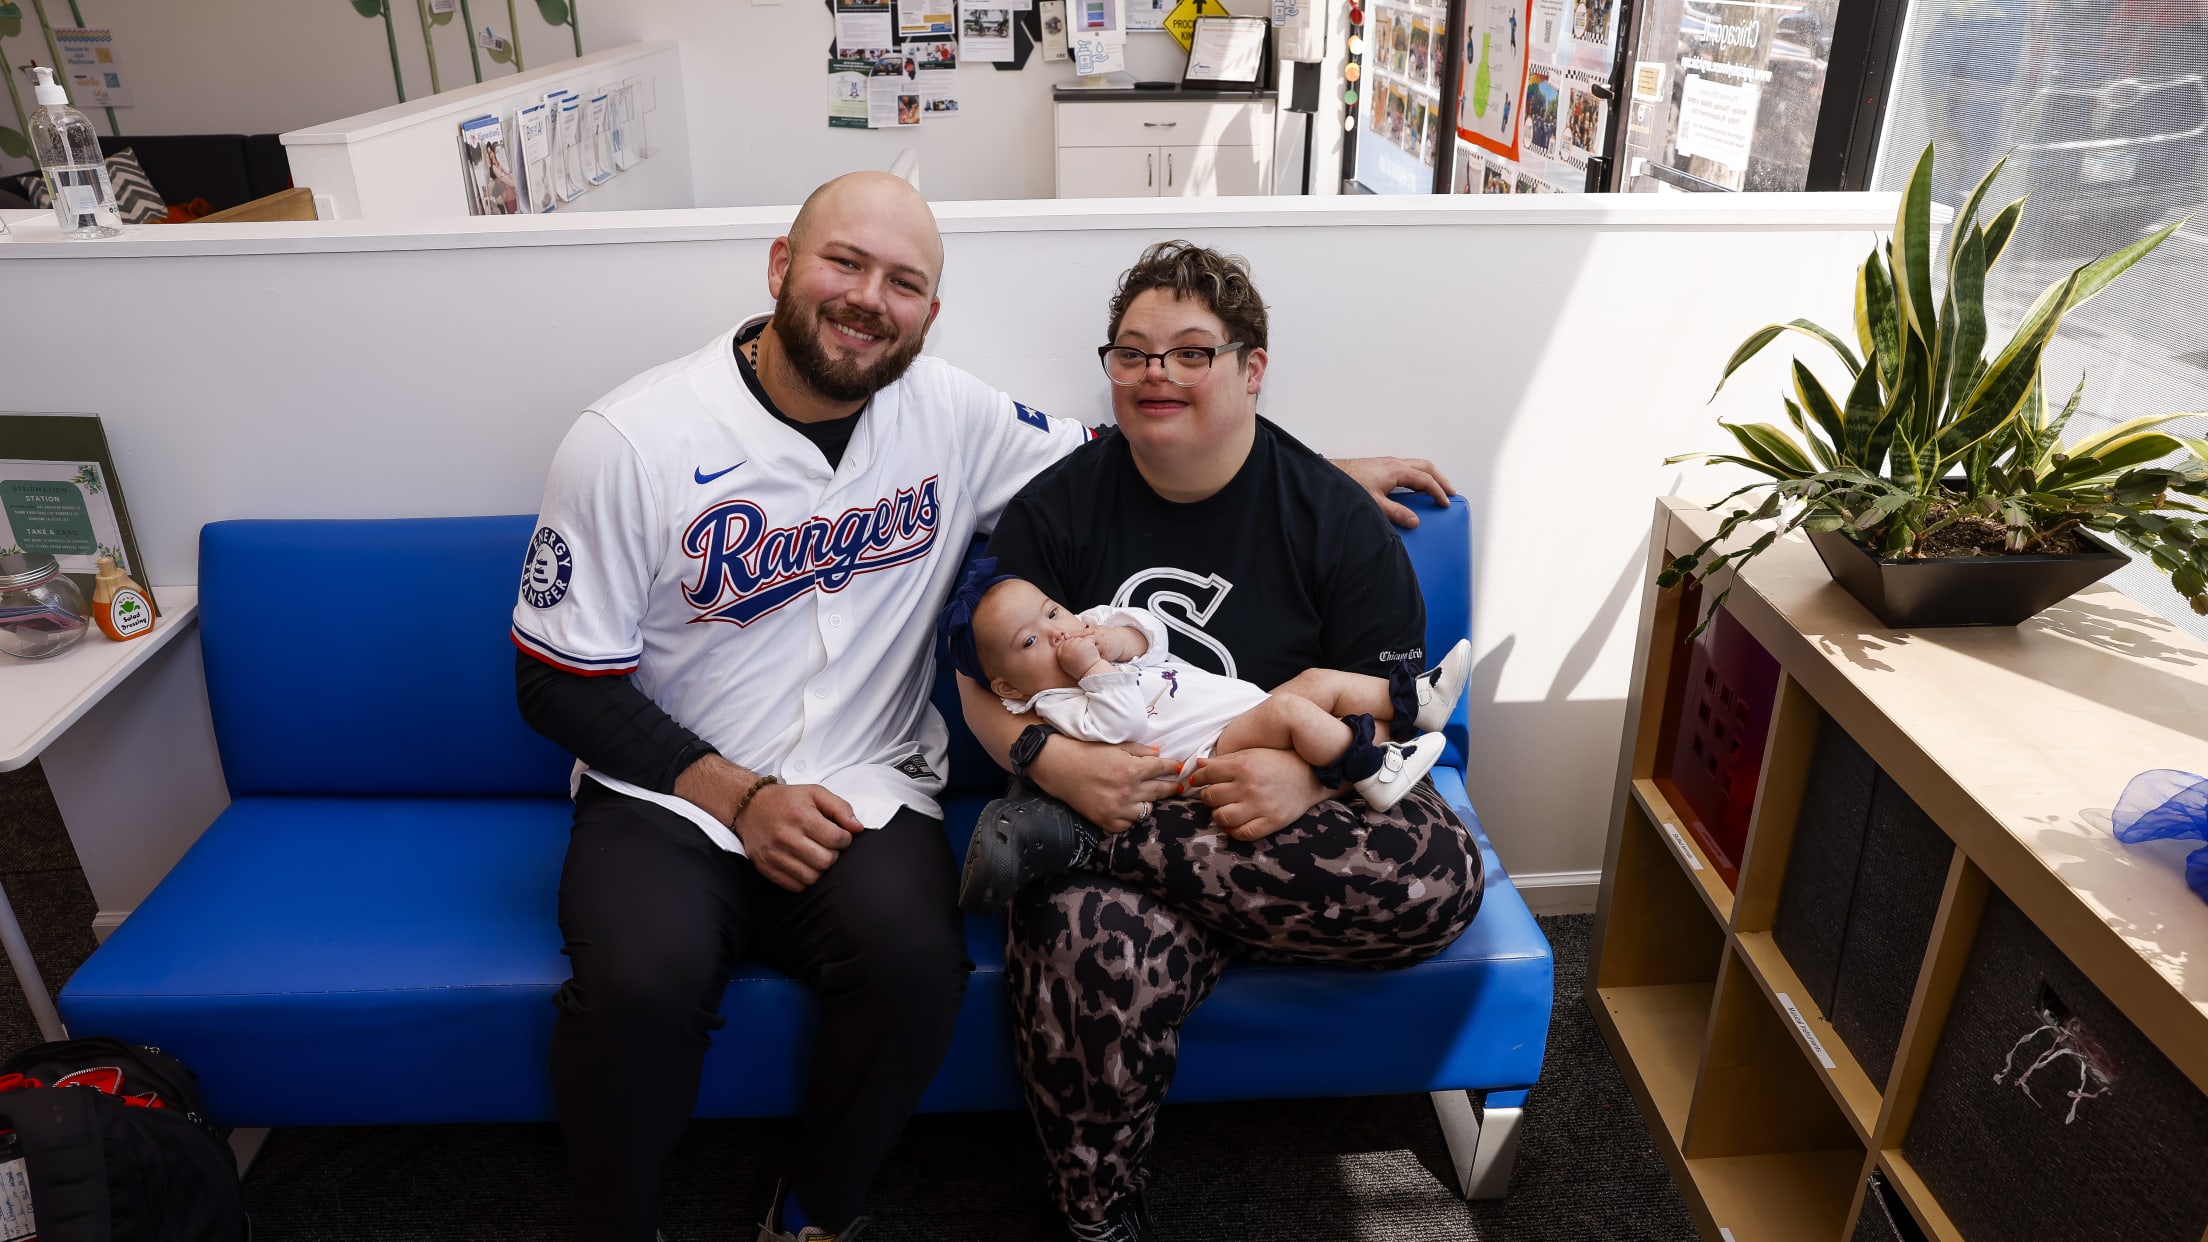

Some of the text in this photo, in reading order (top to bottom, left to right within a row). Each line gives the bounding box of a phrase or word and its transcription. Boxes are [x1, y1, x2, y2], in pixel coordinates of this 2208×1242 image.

[1173, 19, 1193, 29] PROC
[1181, 32, 1194, 40] KIN
[533, 529, 571, 567] ENERGY
[681, 474, 941, 628] Rangers
[522, 562, 568, 607] TRANSFER
[123, 612, 141, 622] Salad
[121, 618, 147, 630] Dressing
